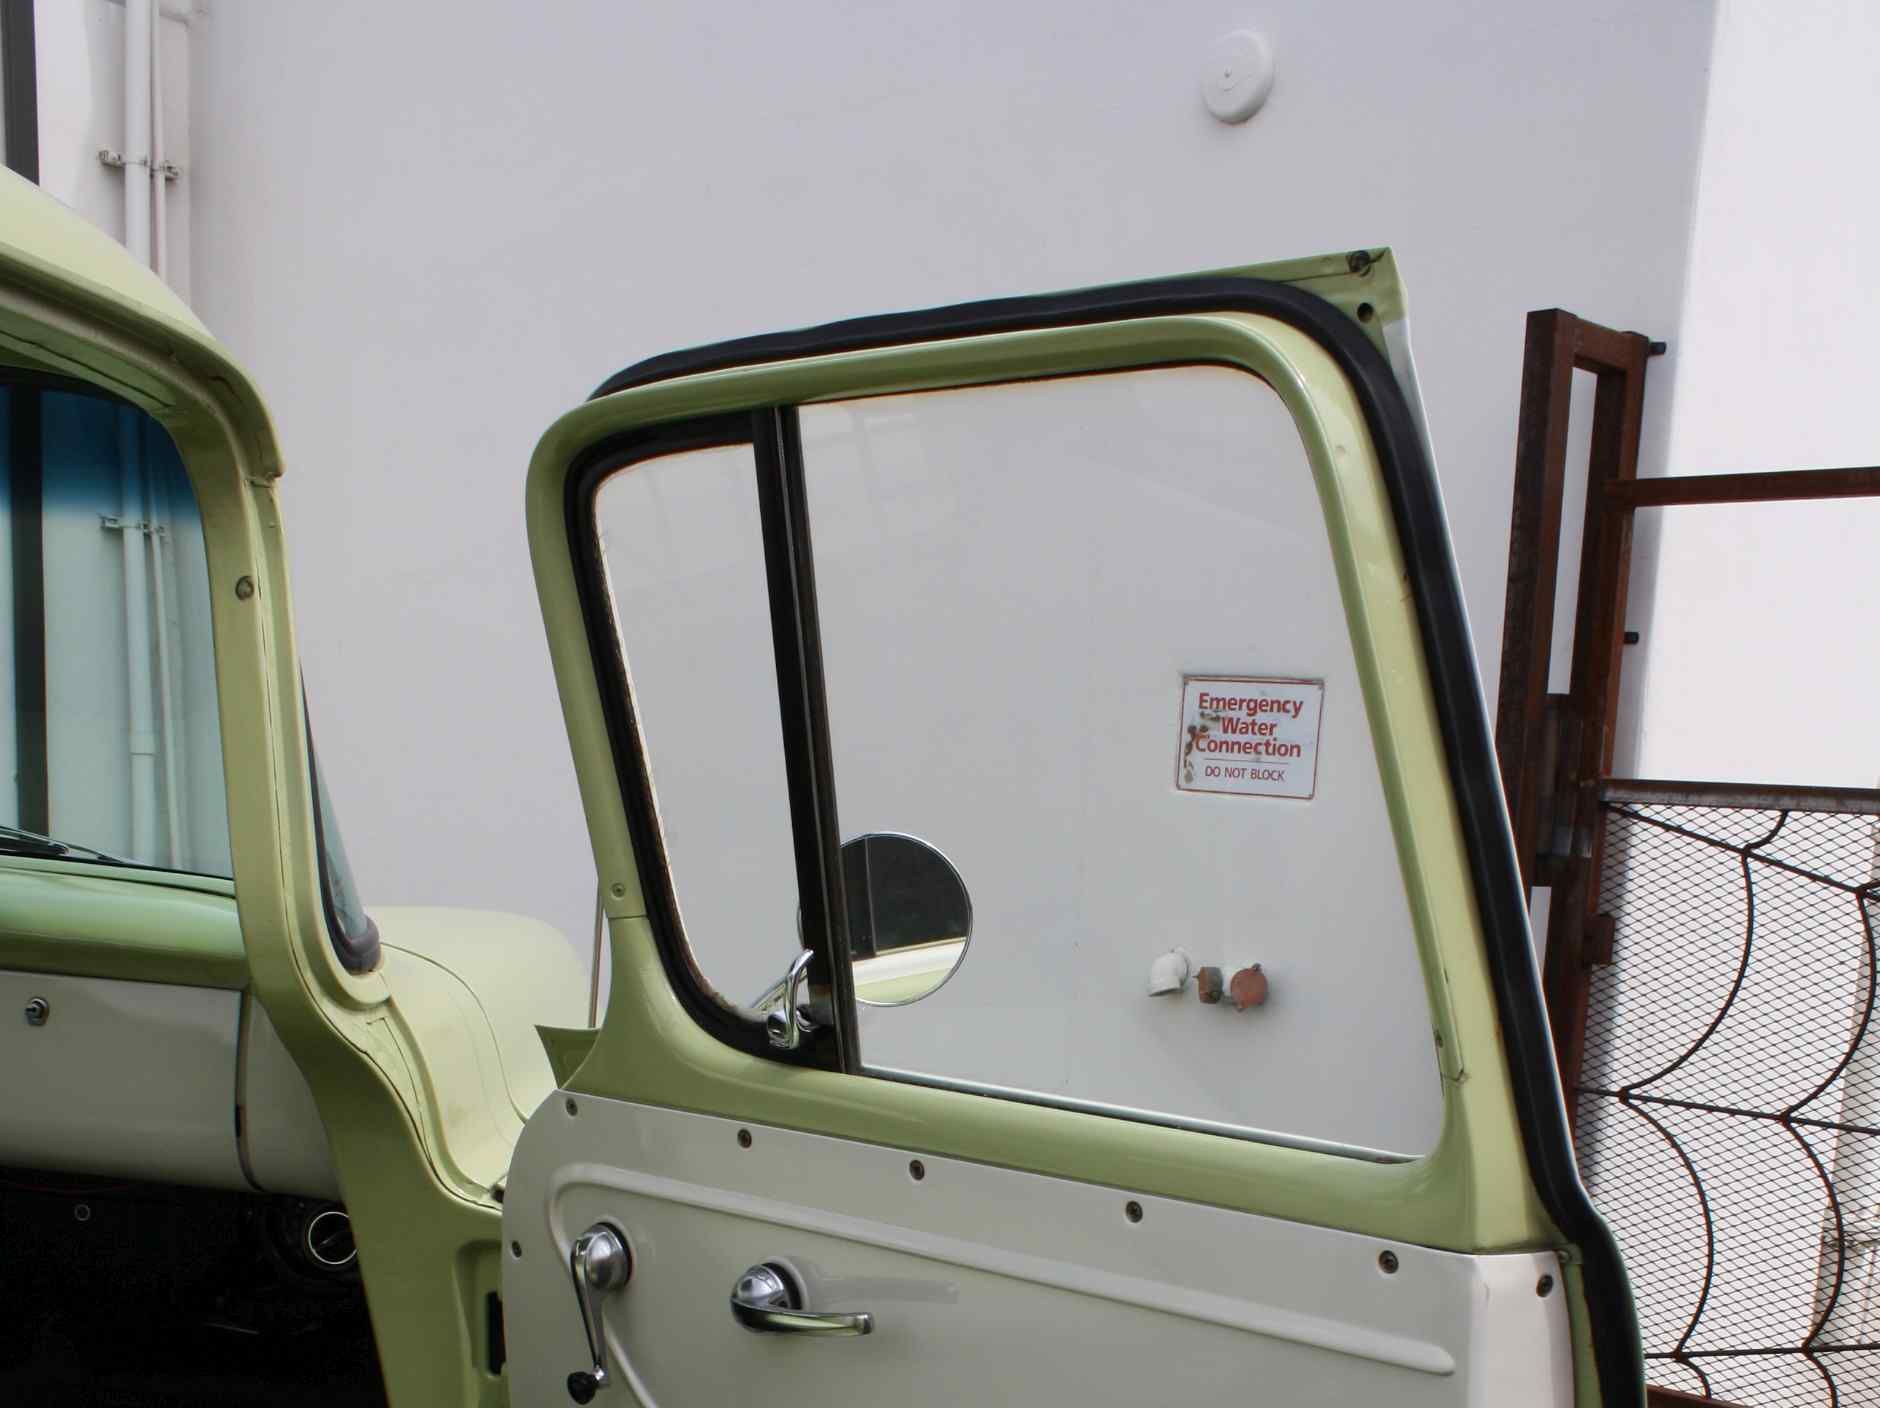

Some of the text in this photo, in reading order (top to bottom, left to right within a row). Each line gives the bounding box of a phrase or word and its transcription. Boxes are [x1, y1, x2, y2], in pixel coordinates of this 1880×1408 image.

[1198, 692, 1304, 719] Emergency
[1221, 717, 1277, 736] Water
[1194, 736, 1301, 758] Connection
[1205, 766, 1286, 782] DO NOT BLOCK
